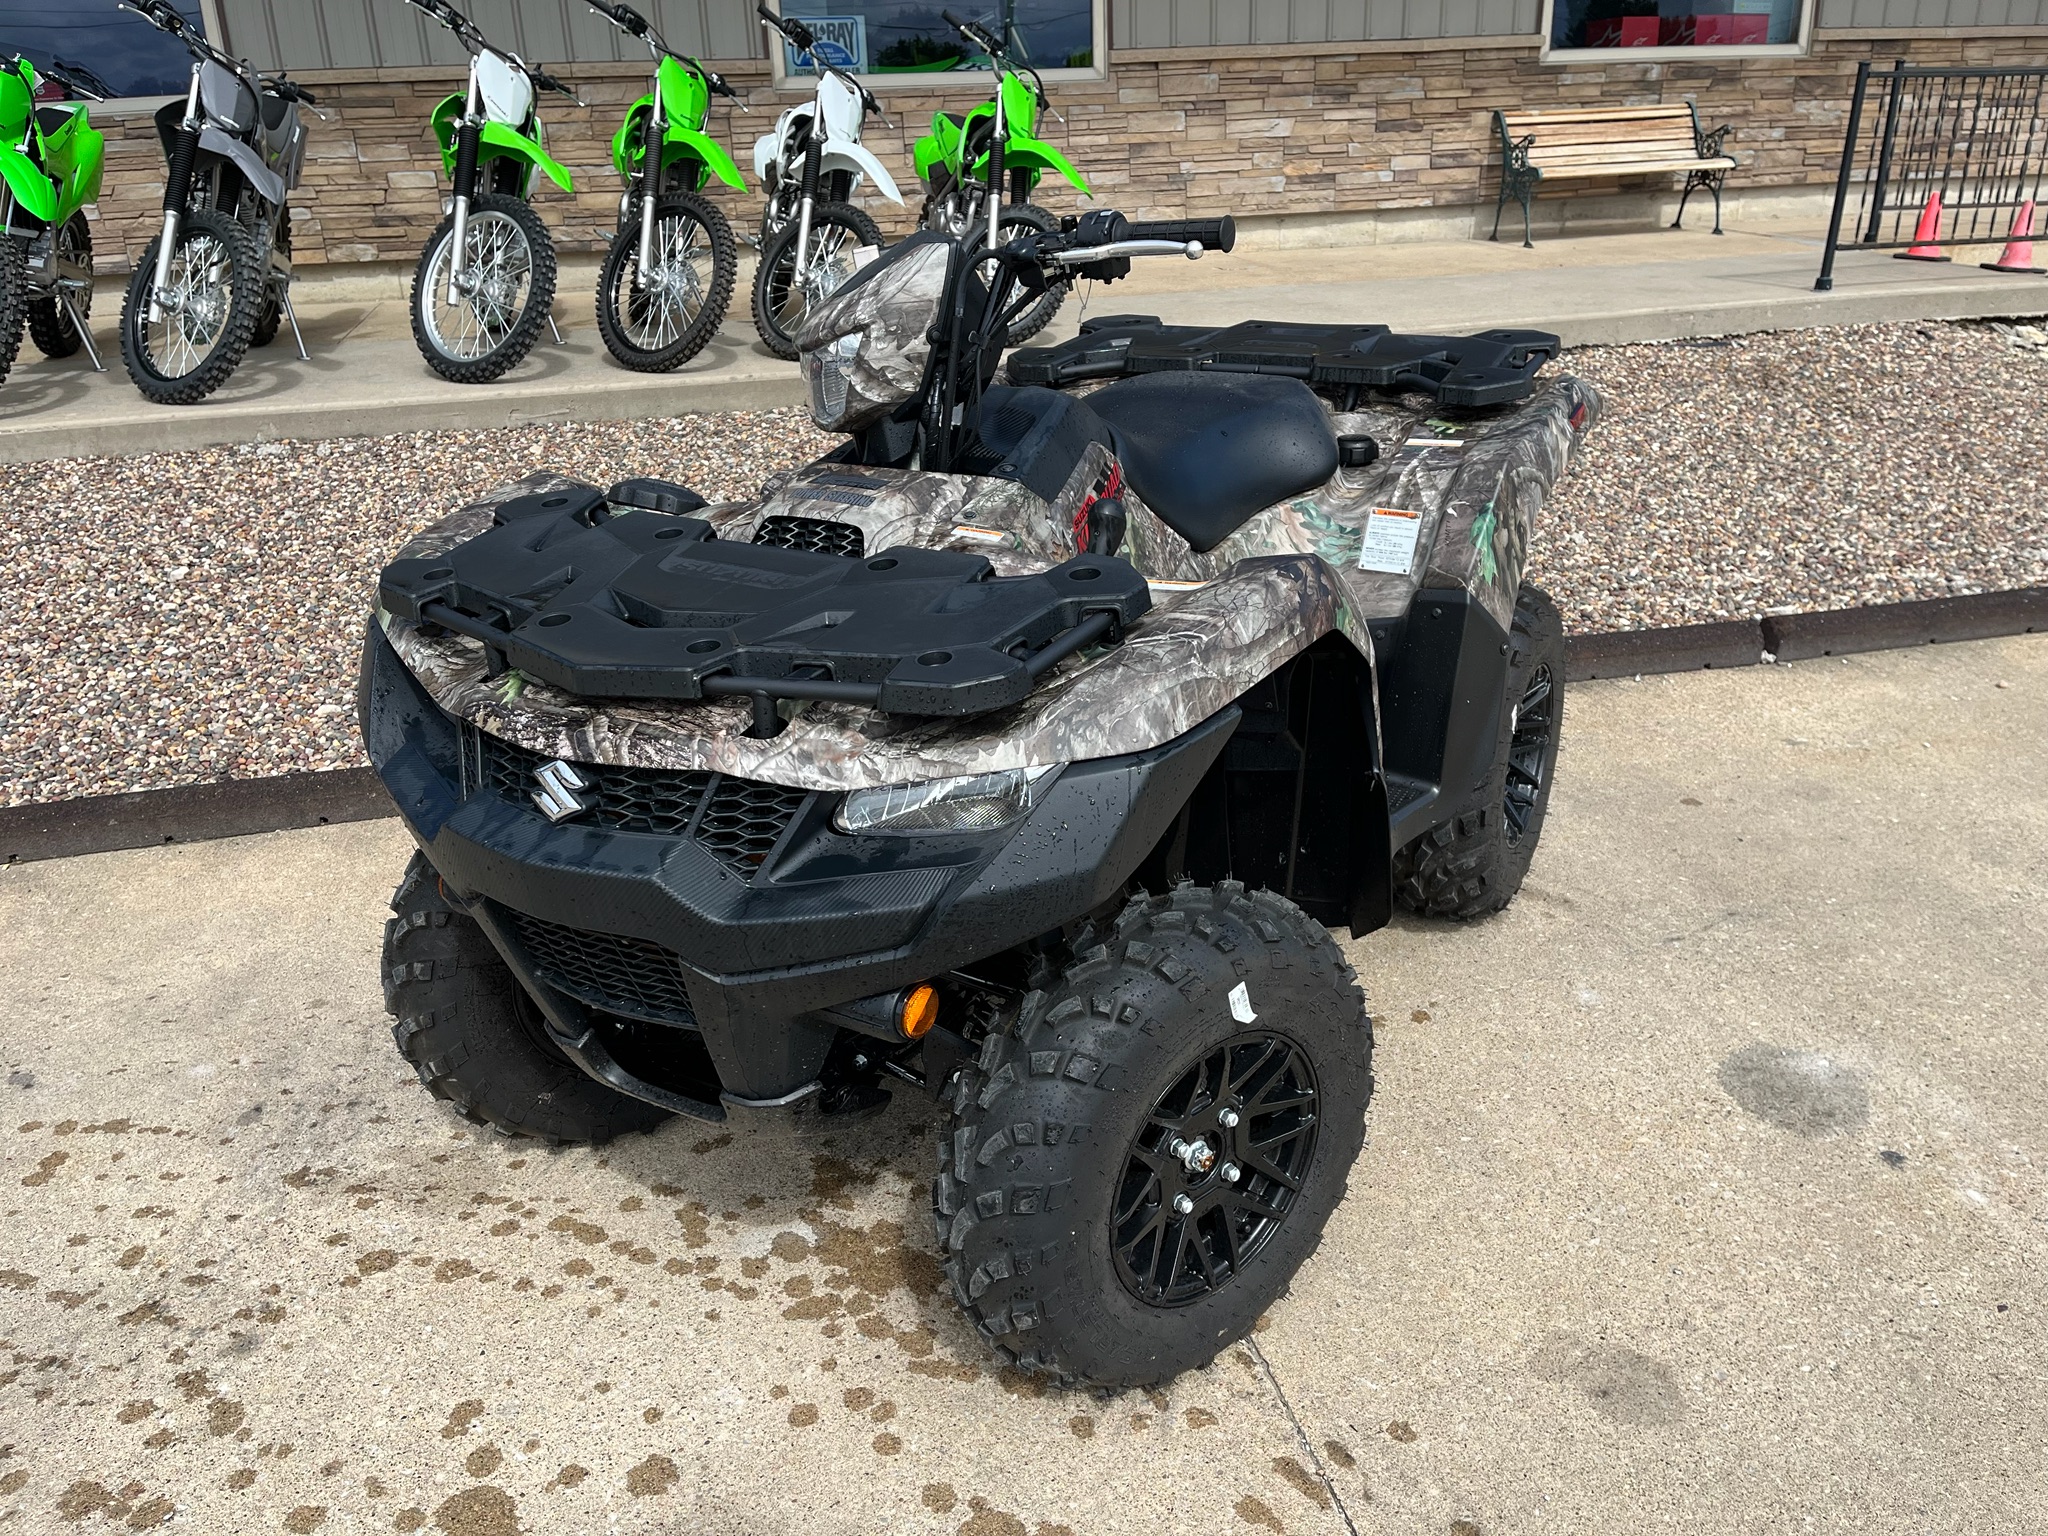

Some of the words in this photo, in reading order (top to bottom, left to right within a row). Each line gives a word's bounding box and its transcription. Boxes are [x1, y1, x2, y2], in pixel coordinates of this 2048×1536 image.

[826, 22, 855, 59] RAY
[788, 488, 827, 499] POWER
[824, 490, 877, 507] STEERING
